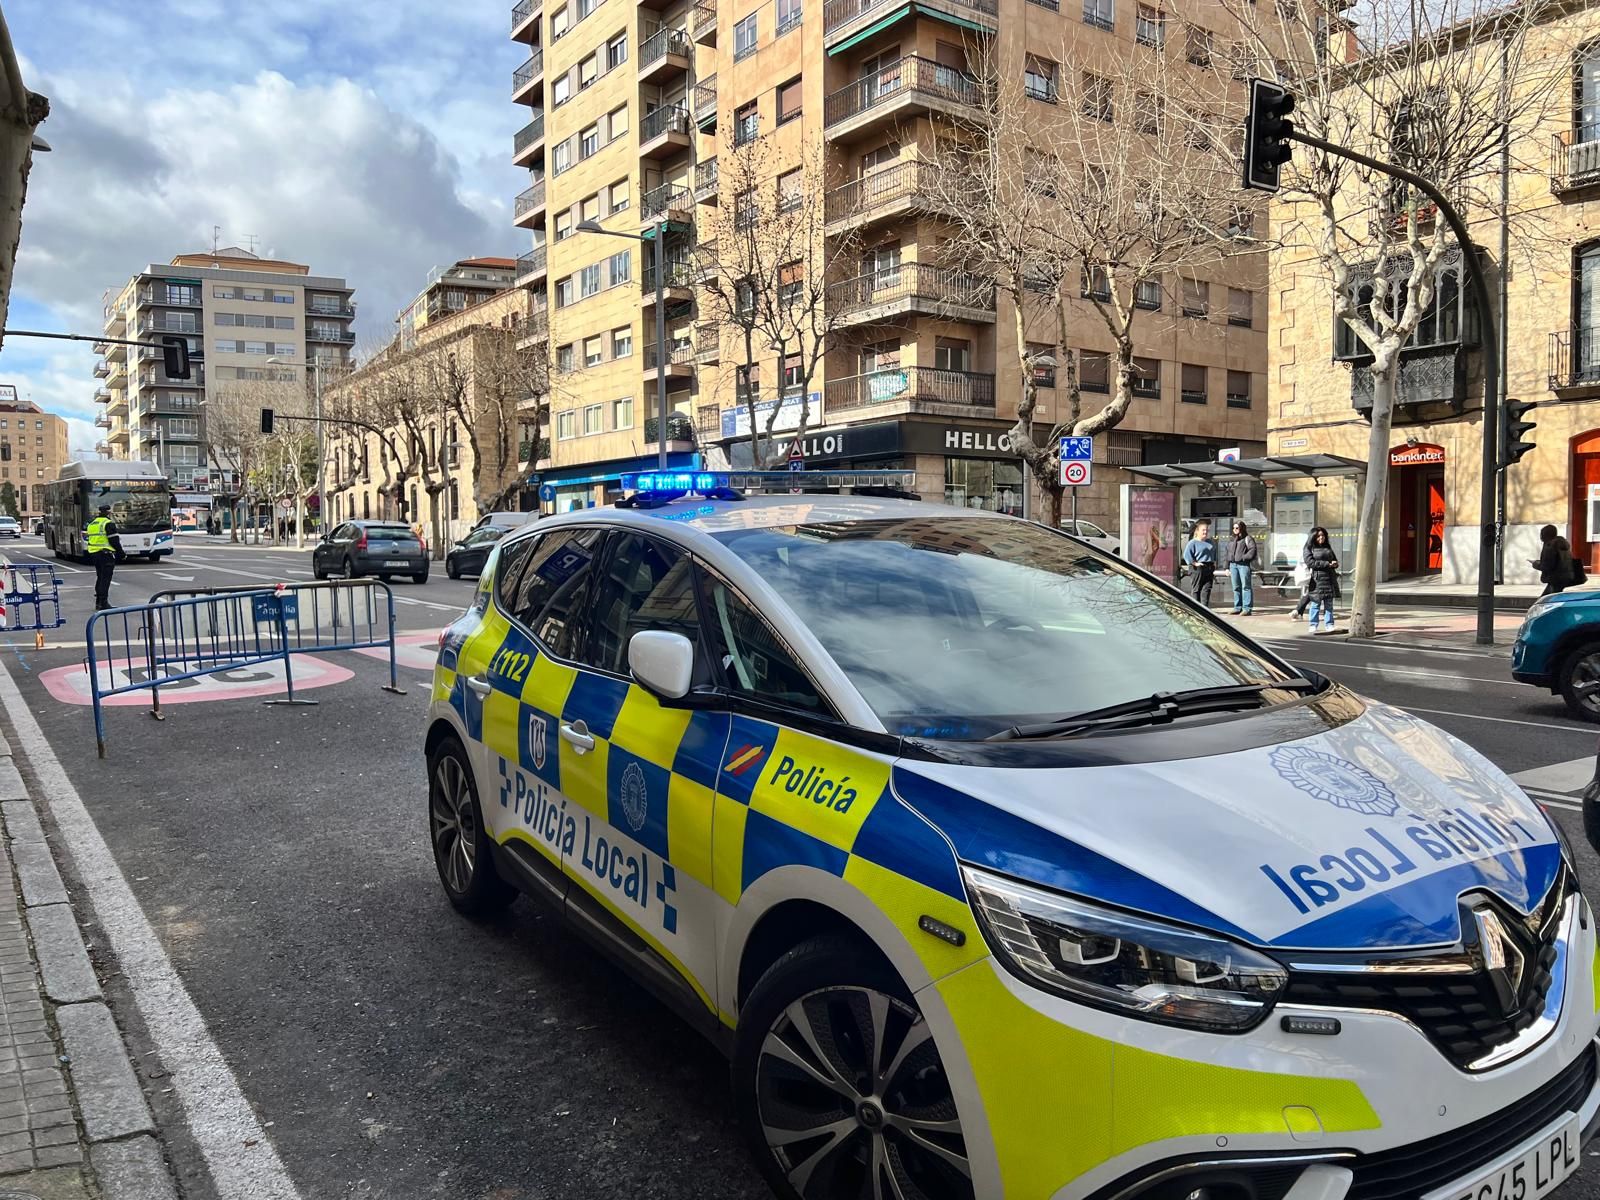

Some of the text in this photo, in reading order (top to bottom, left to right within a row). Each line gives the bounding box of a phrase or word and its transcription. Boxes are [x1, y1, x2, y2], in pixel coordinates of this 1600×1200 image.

[777, 436, 836, 457] HLLO
[945, 430, 1011, 452] HELLO
[1070, 469, 1082, 477] 20
[262, 604, 296, 616] aqulia
[499, 649, 530, 682] 112
[770, 755, 857, 814] Policía
[514, 771, 649, 909] Policía Local
[1459, 1130, 1576, 1200] 45 LPL
